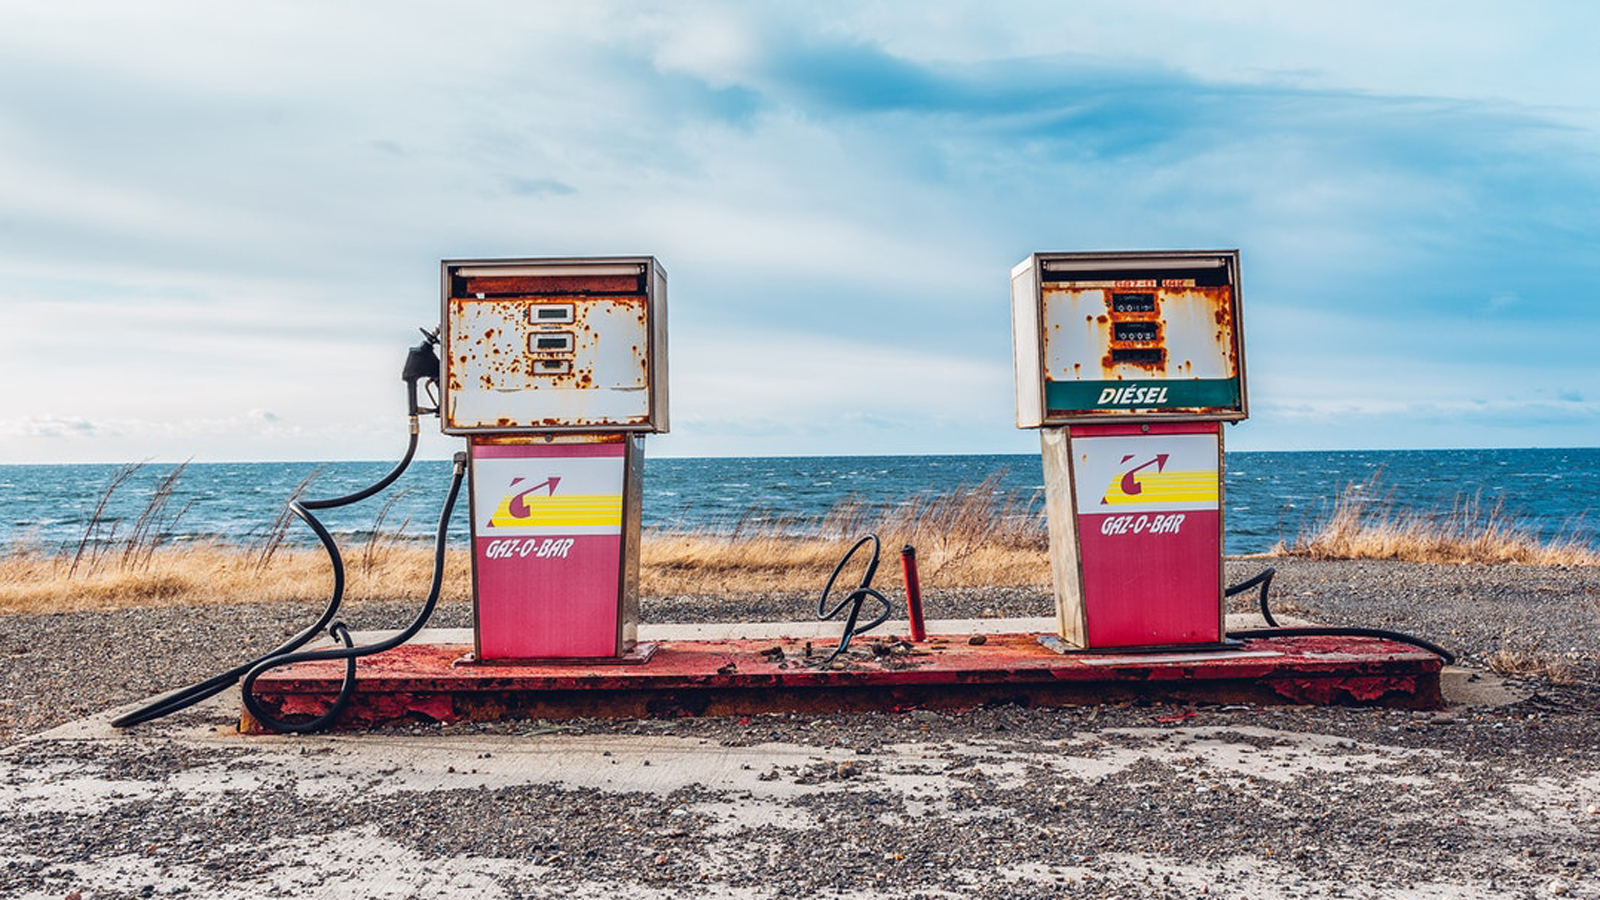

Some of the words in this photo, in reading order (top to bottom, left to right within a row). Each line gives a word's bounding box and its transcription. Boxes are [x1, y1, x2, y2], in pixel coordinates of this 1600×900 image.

[1097, 384, 1168, 405] DIÉSEL
[1100, 514, 1186, 536] GAZ-O-BAR
[486, 538, 575, 559] GAZ-O-BAR
